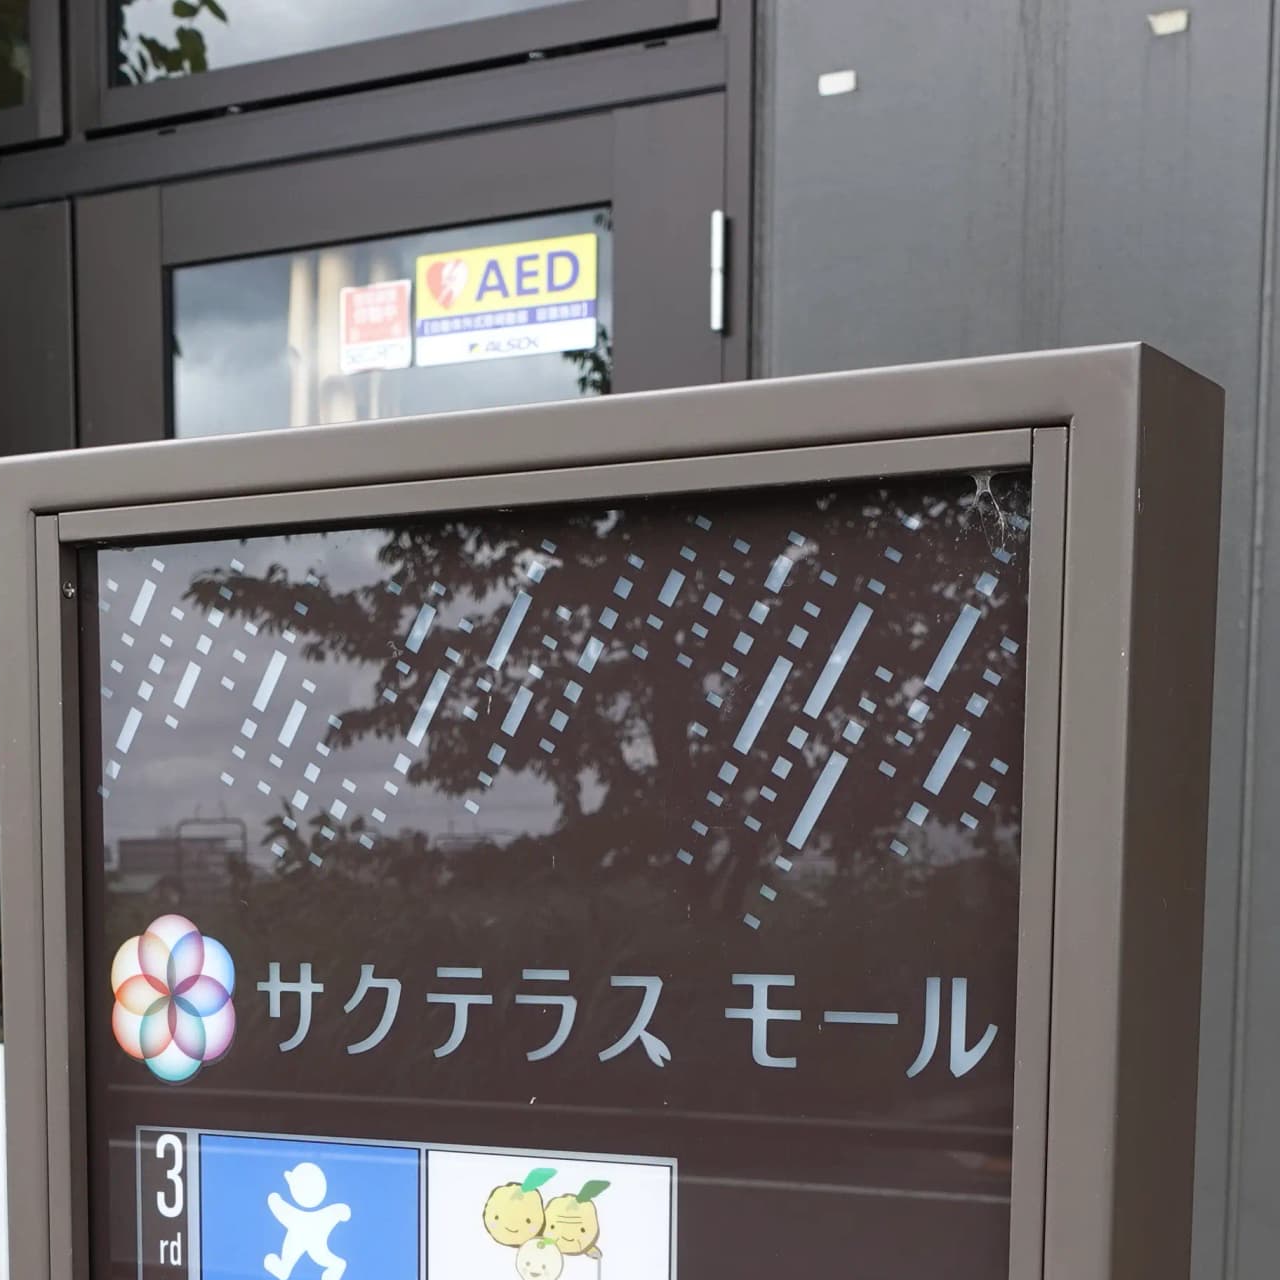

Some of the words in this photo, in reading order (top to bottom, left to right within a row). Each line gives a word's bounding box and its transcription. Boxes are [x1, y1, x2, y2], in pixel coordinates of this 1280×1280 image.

[475, 250, 580, 302] AED
[257, 962, 671, 1067] サクテラス
[725, 974, 998, 1079] モール
[156, 1133, 184, 1218] 3
[160, 1232, 182, 1266] rd
